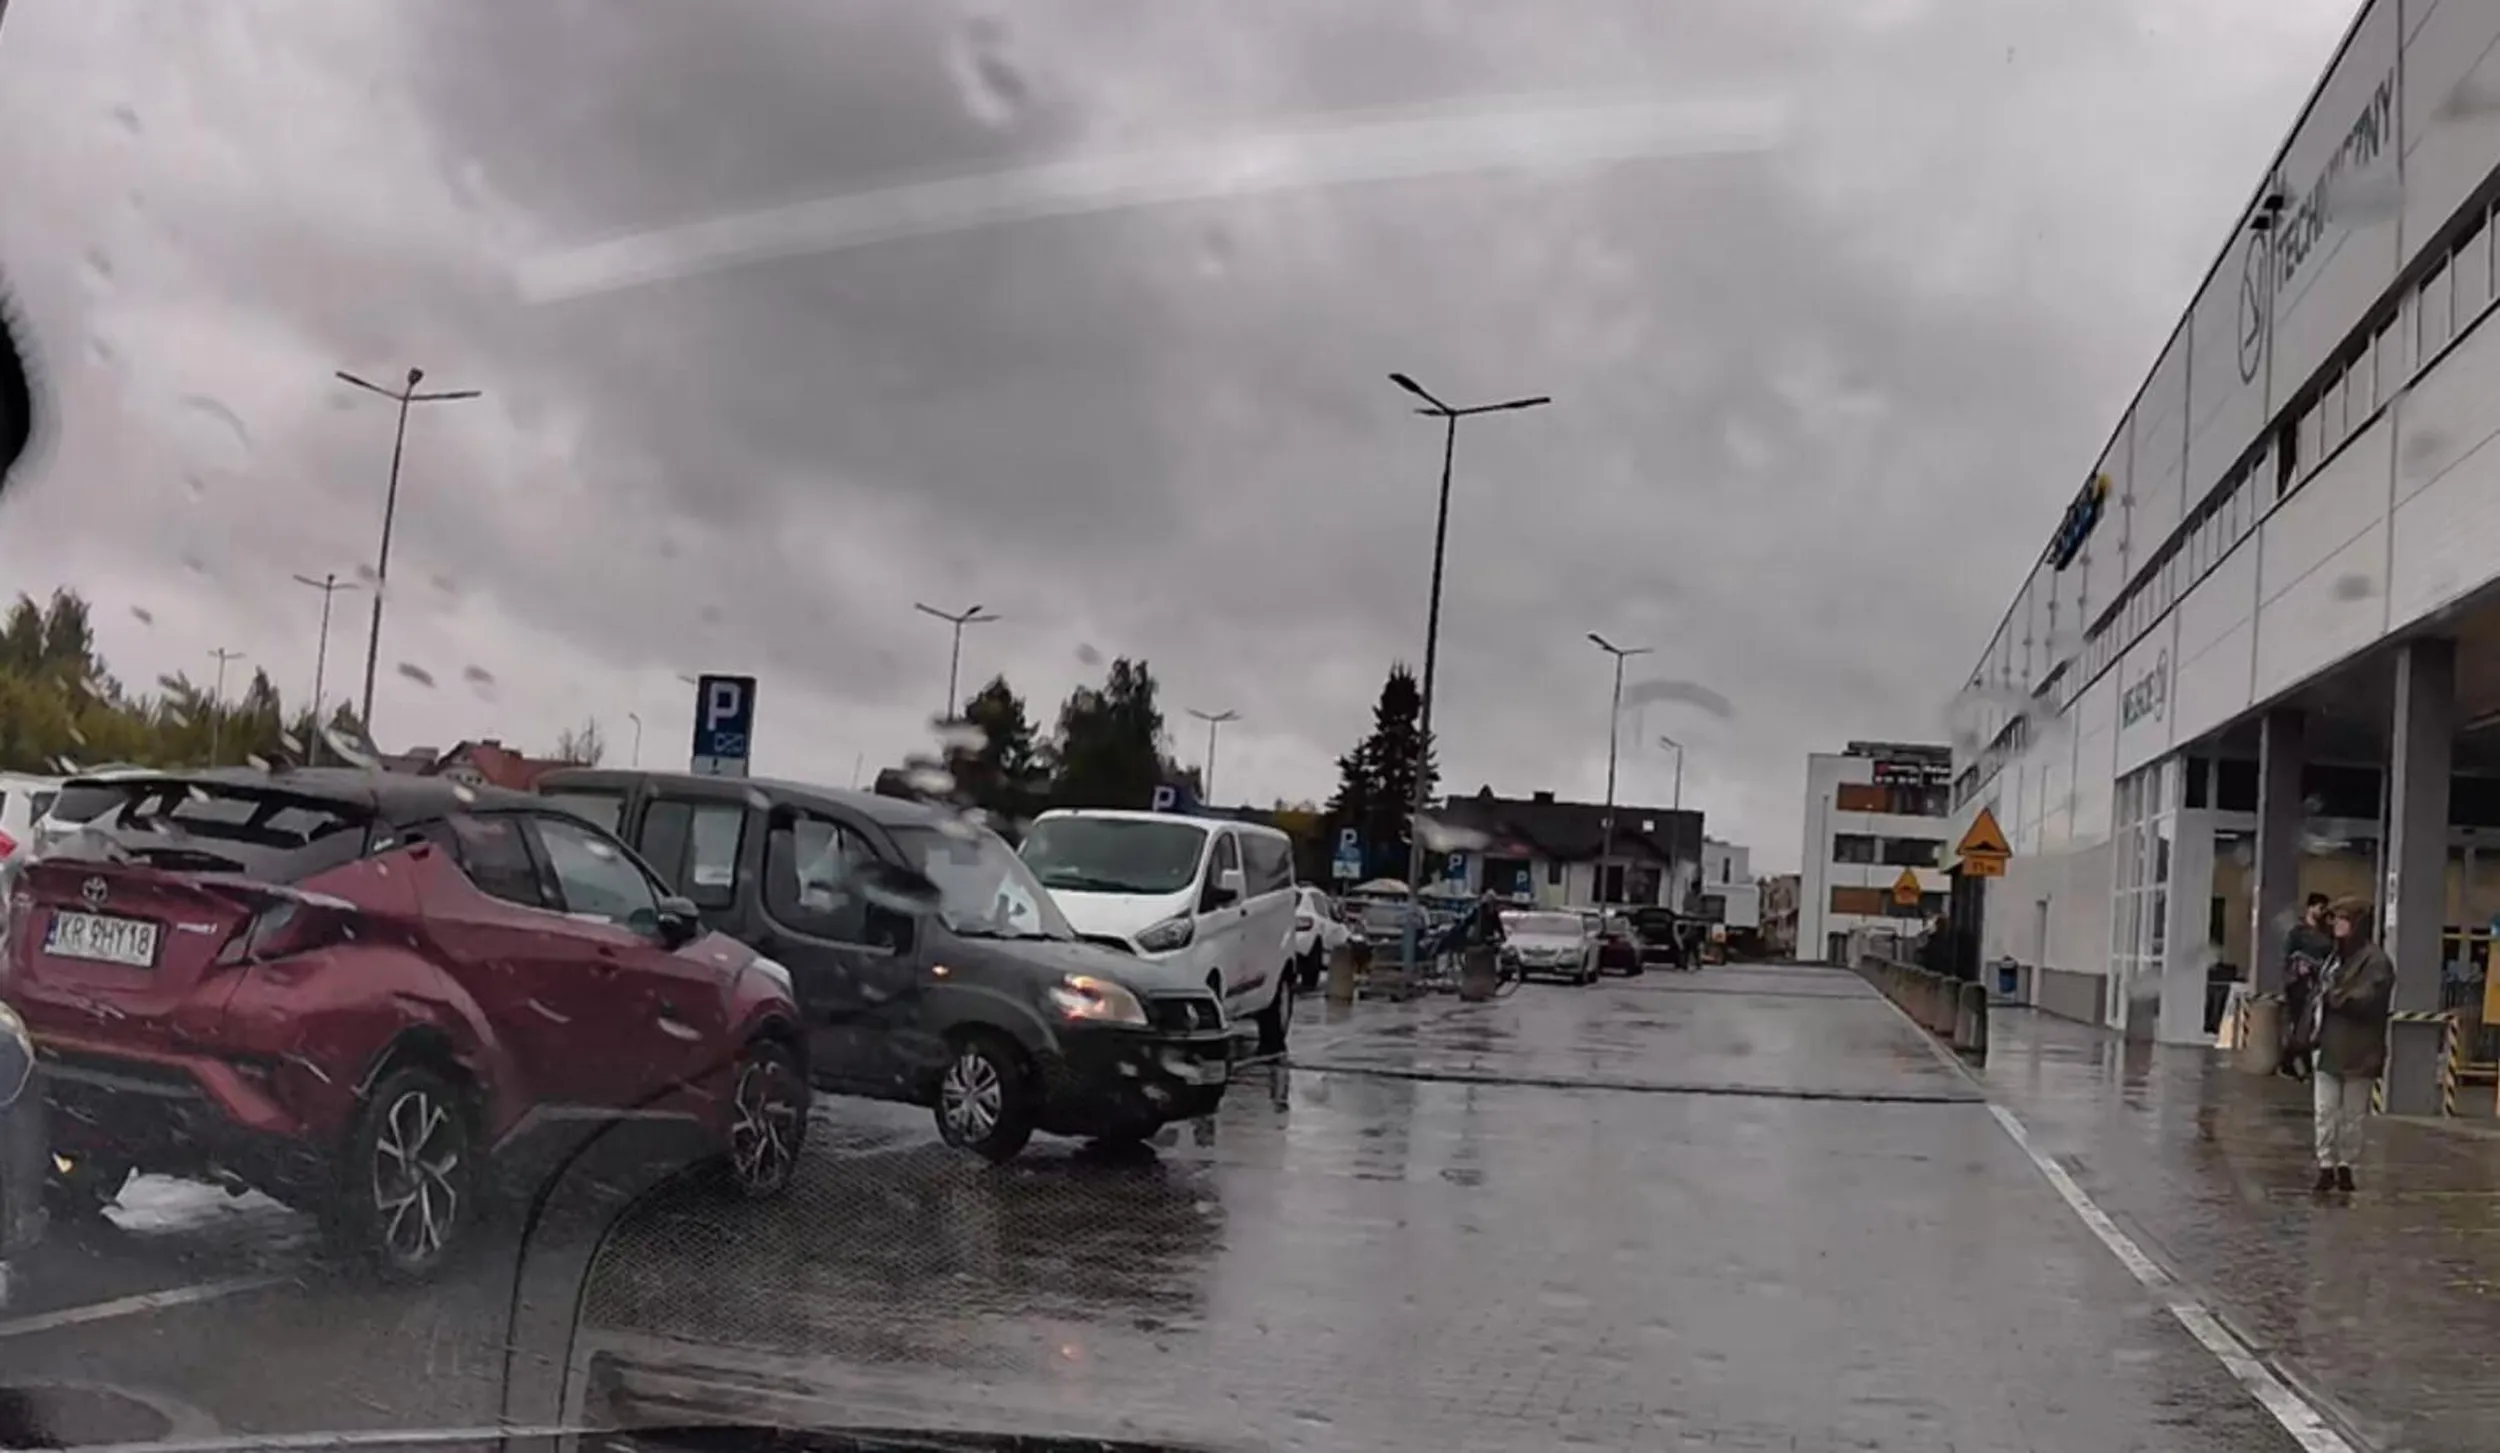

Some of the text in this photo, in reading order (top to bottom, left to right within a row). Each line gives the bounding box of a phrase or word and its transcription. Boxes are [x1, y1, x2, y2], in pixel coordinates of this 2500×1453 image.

[706, 682, 741, 731] P
[1152, 785, 1176, 813] P
[1340, 828, 1357, 850] P
[1448, 853, 1463, 870] P
[1516, 870, 1528, 884] P
[59, 915, 86, 948] KR
